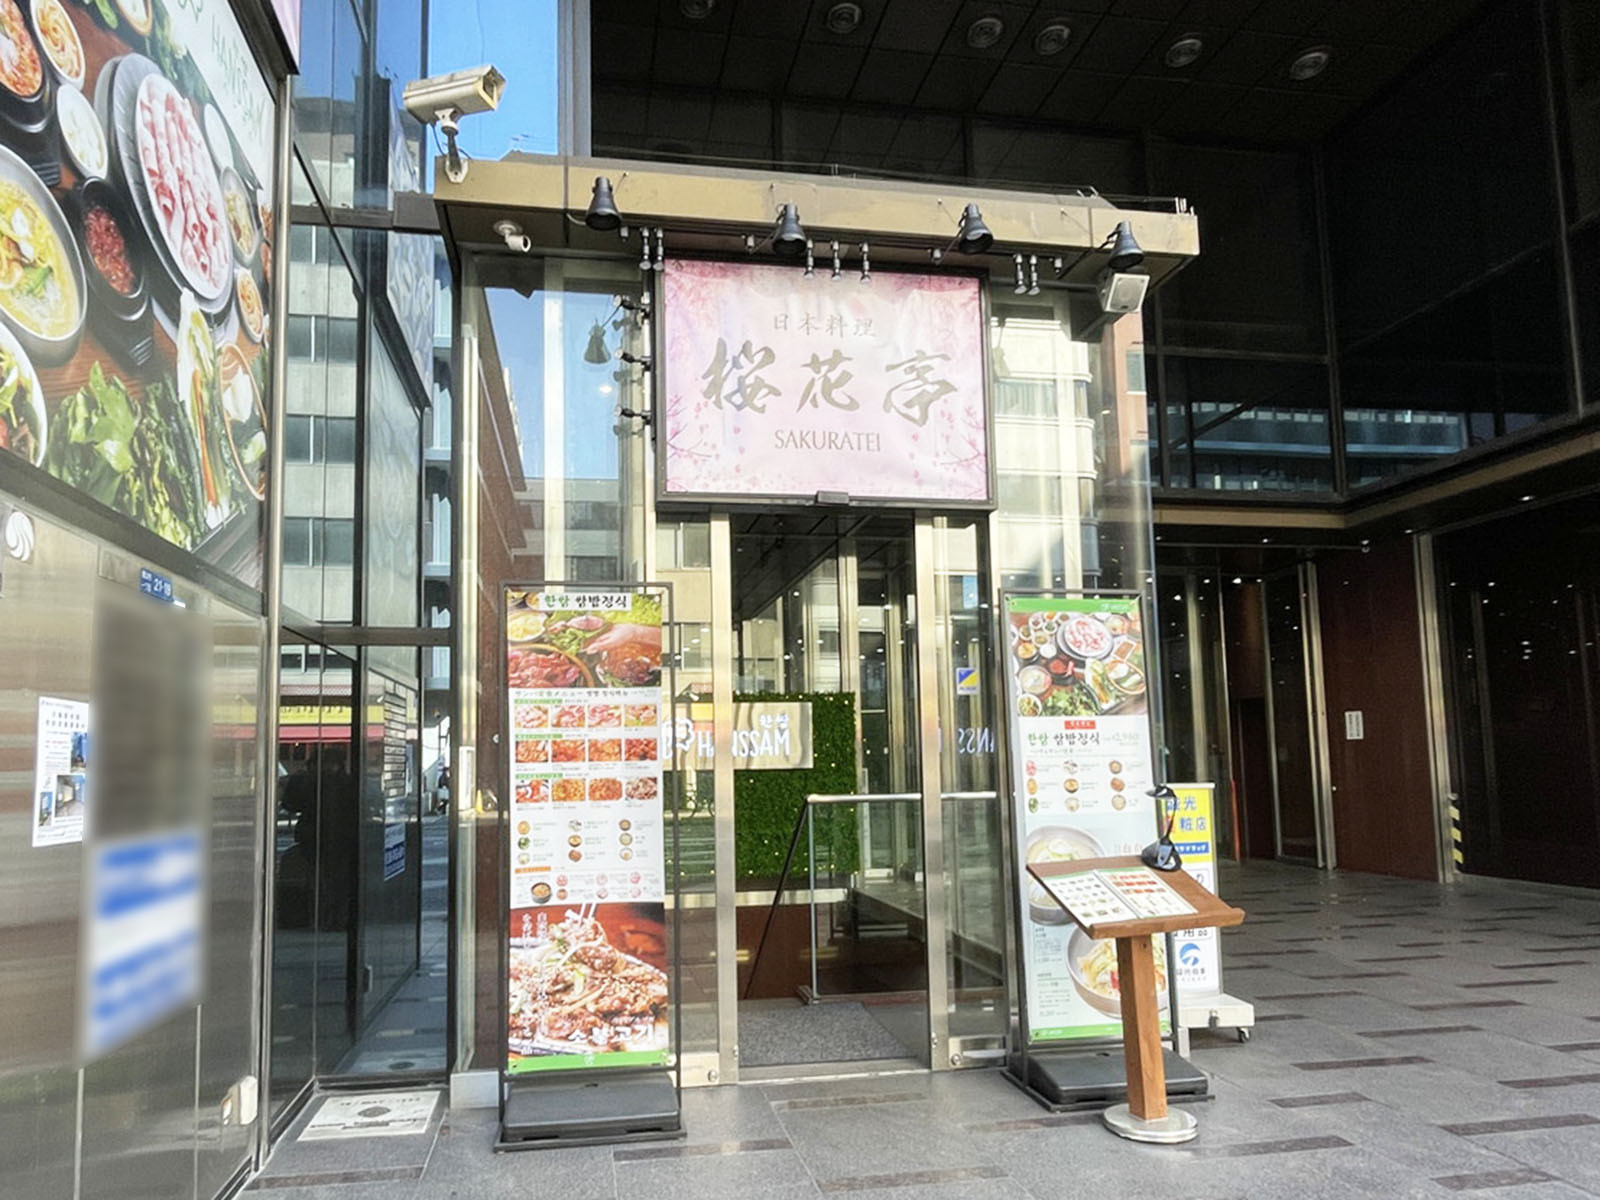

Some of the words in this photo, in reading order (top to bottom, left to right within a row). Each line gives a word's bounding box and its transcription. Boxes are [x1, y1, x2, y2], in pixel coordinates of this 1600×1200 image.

[773, 313, 876, 338] 日本料理
[701, 336, 957, 427] 桜花亭
[774, 429, 881, 452] SAKURATEI
